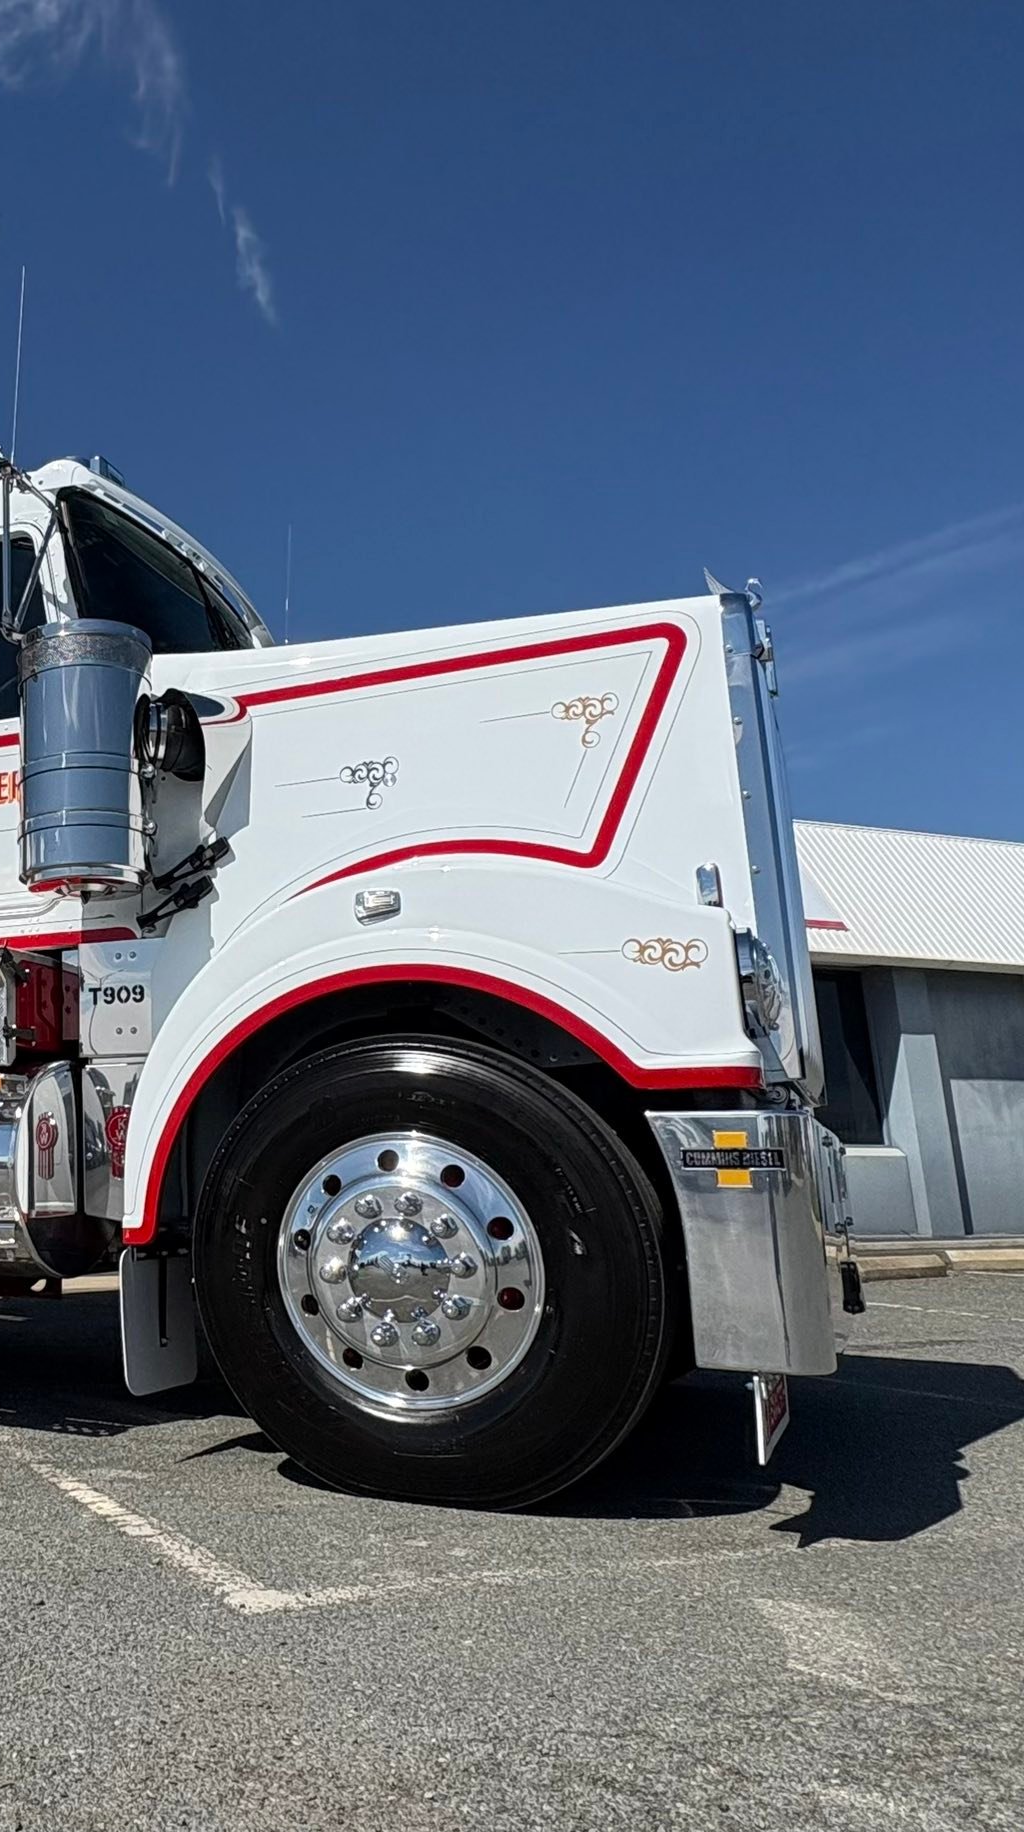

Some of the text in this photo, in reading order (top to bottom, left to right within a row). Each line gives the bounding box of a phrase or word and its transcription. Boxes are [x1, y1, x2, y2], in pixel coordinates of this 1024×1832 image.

[88, 984, 145, 1006] T909
[685, 1151, 782, 1166] CUMMINS DIESEL
